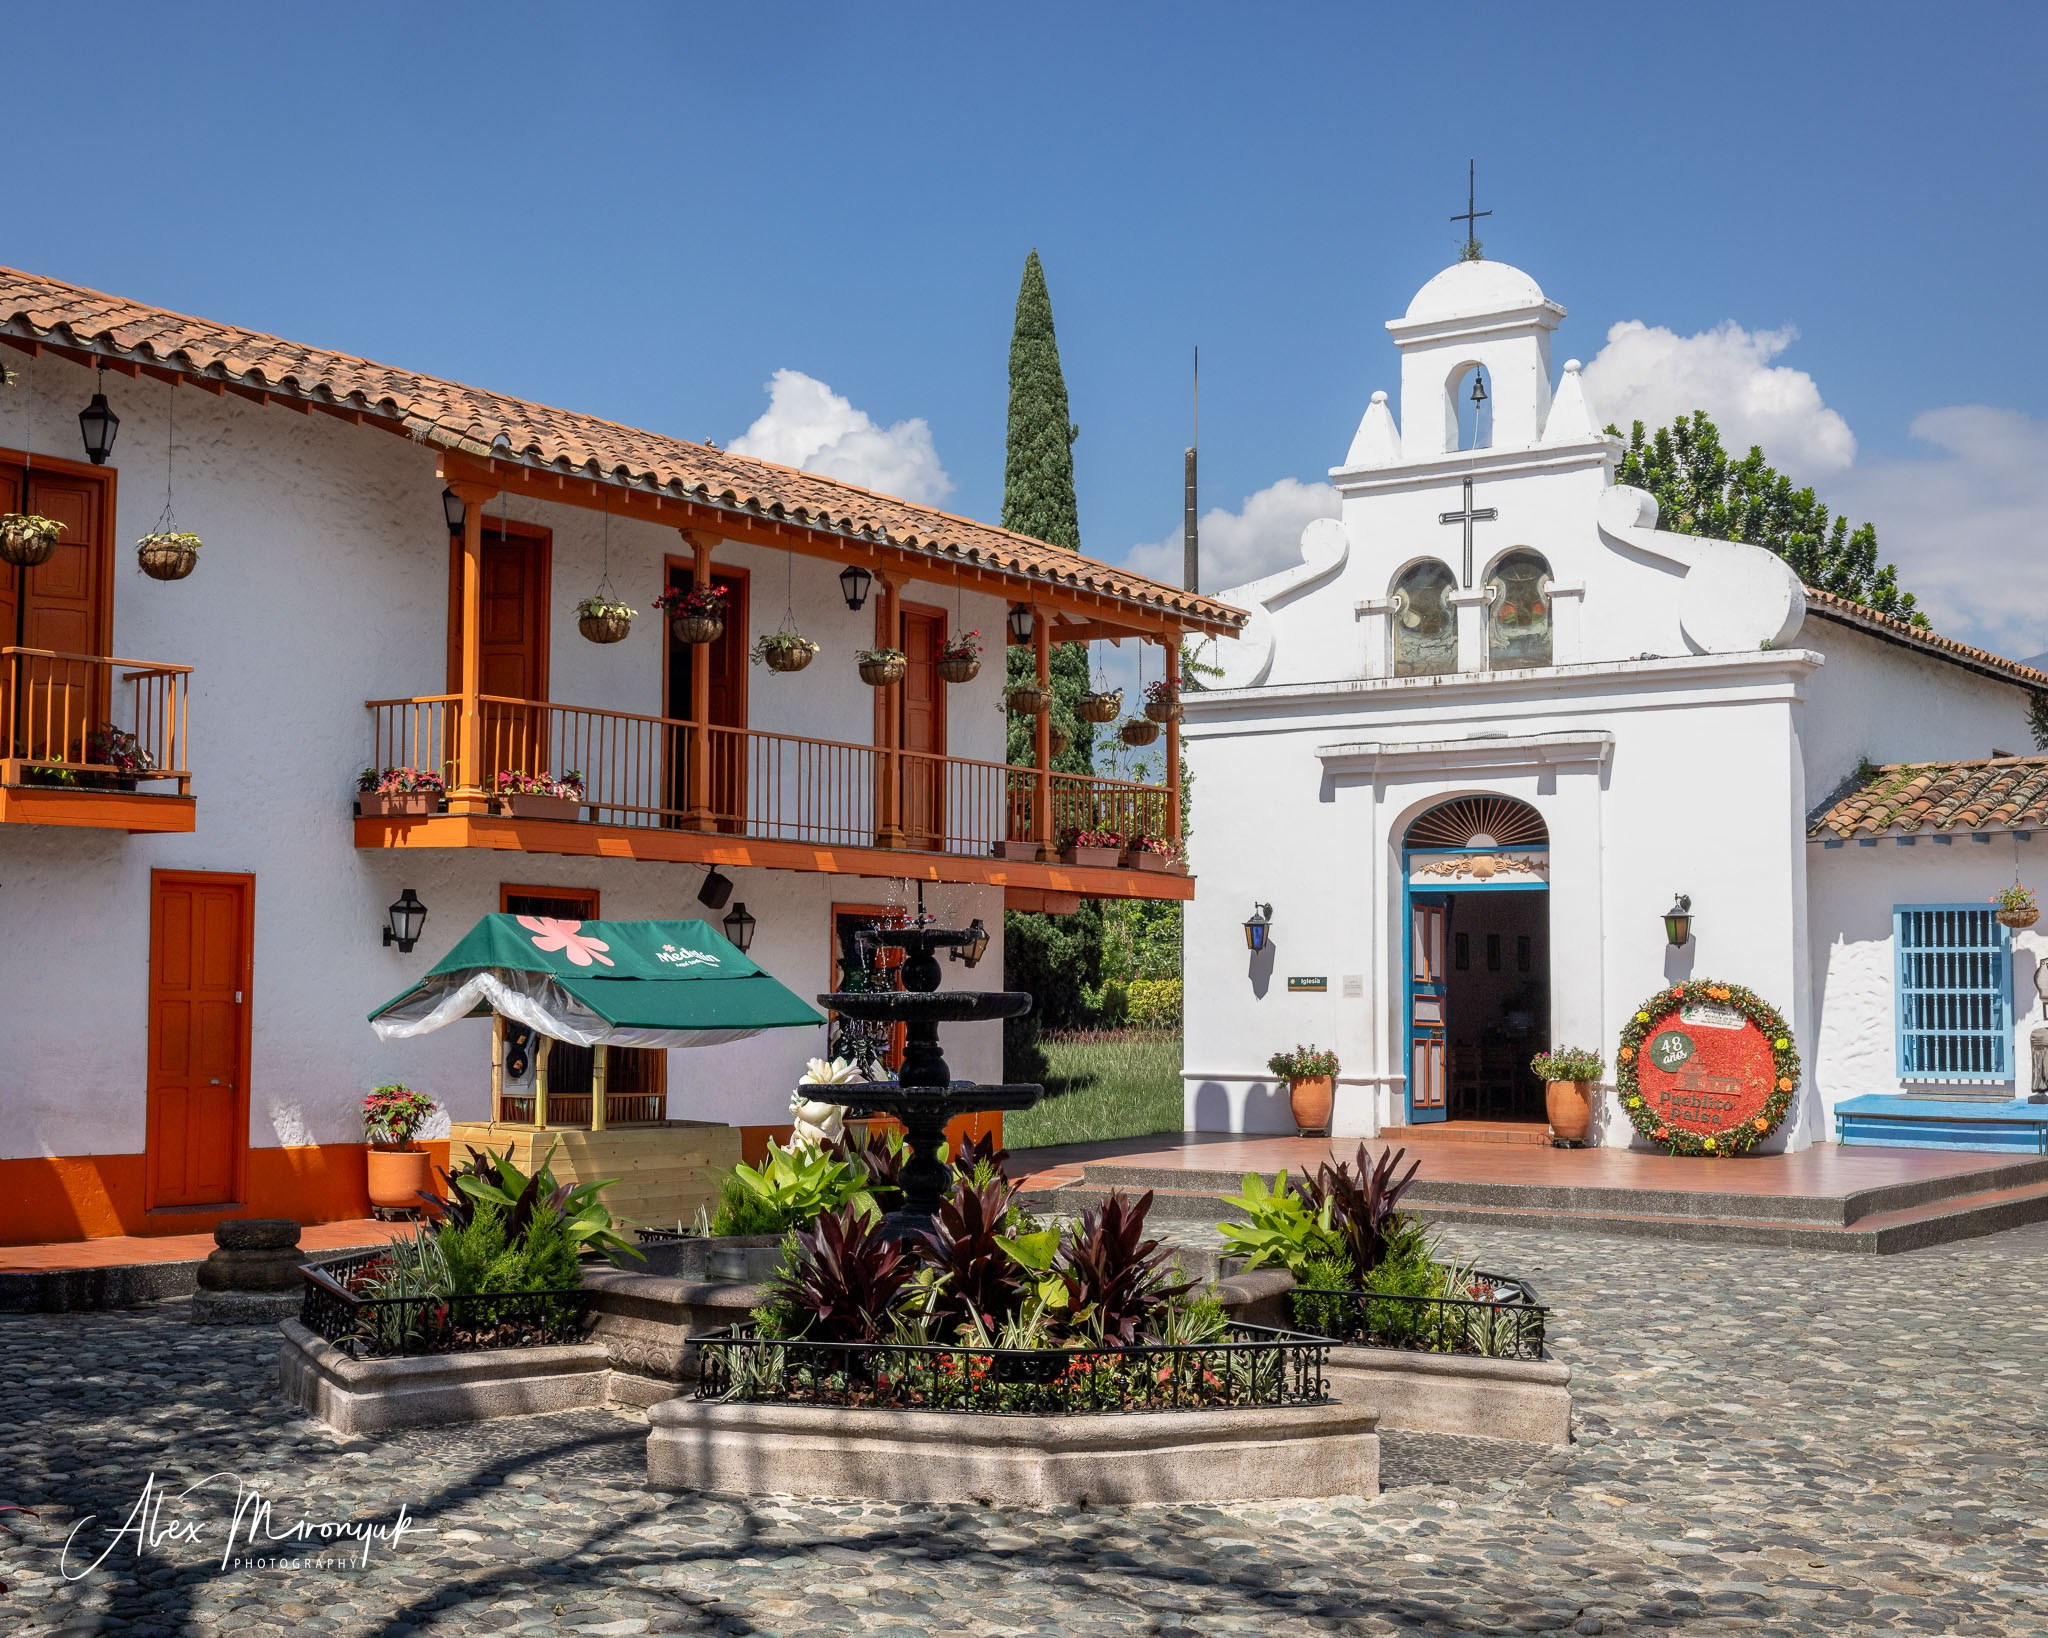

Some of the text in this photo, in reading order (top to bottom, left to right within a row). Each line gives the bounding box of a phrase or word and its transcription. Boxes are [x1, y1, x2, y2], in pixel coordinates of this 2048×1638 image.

[1300, 977, 1321, 985] Iglesia
[1660, 1036, 1682, 1053] 48
[1663, 1050, 1688, 1064] años
[1659, 1090, 1734, 1111] Pueblito
